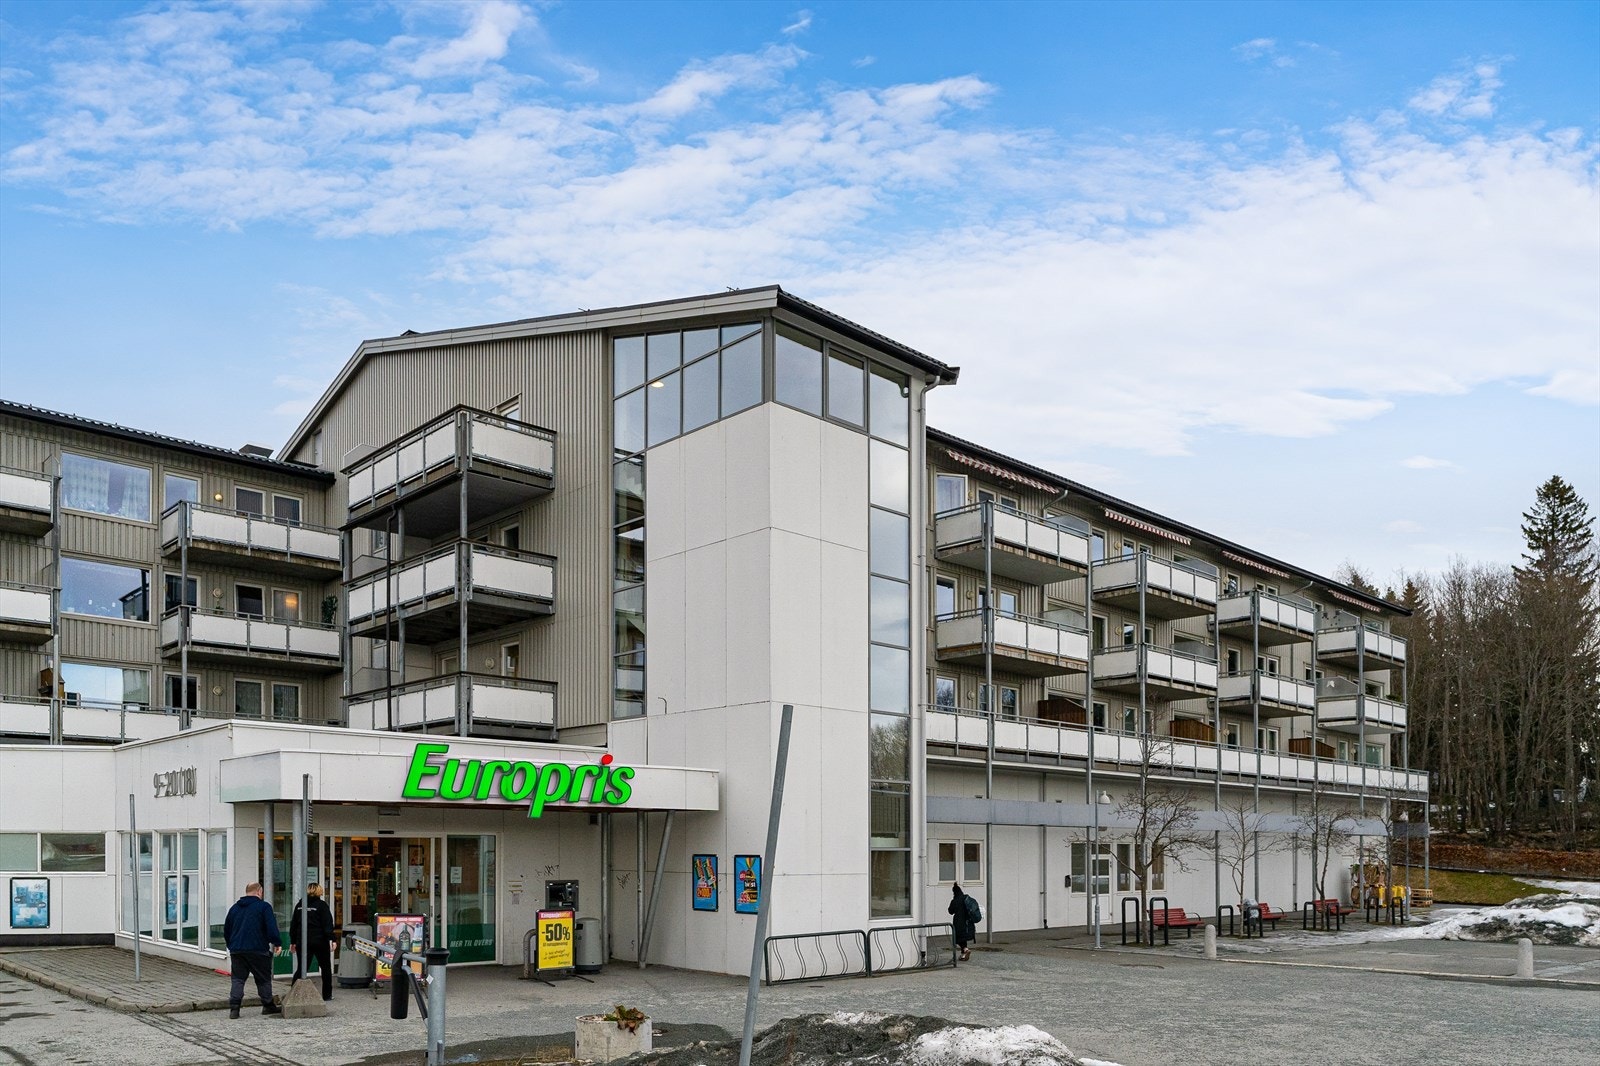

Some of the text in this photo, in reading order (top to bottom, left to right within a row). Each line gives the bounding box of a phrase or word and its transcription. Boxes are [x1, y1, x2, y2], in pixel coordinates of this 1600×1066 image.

[402, 742, 636, 819] Europris
[541, 923, 570, 942] -50%
[449, 940, 463, 948] MER
[464, 939, 473, 947] TIL
